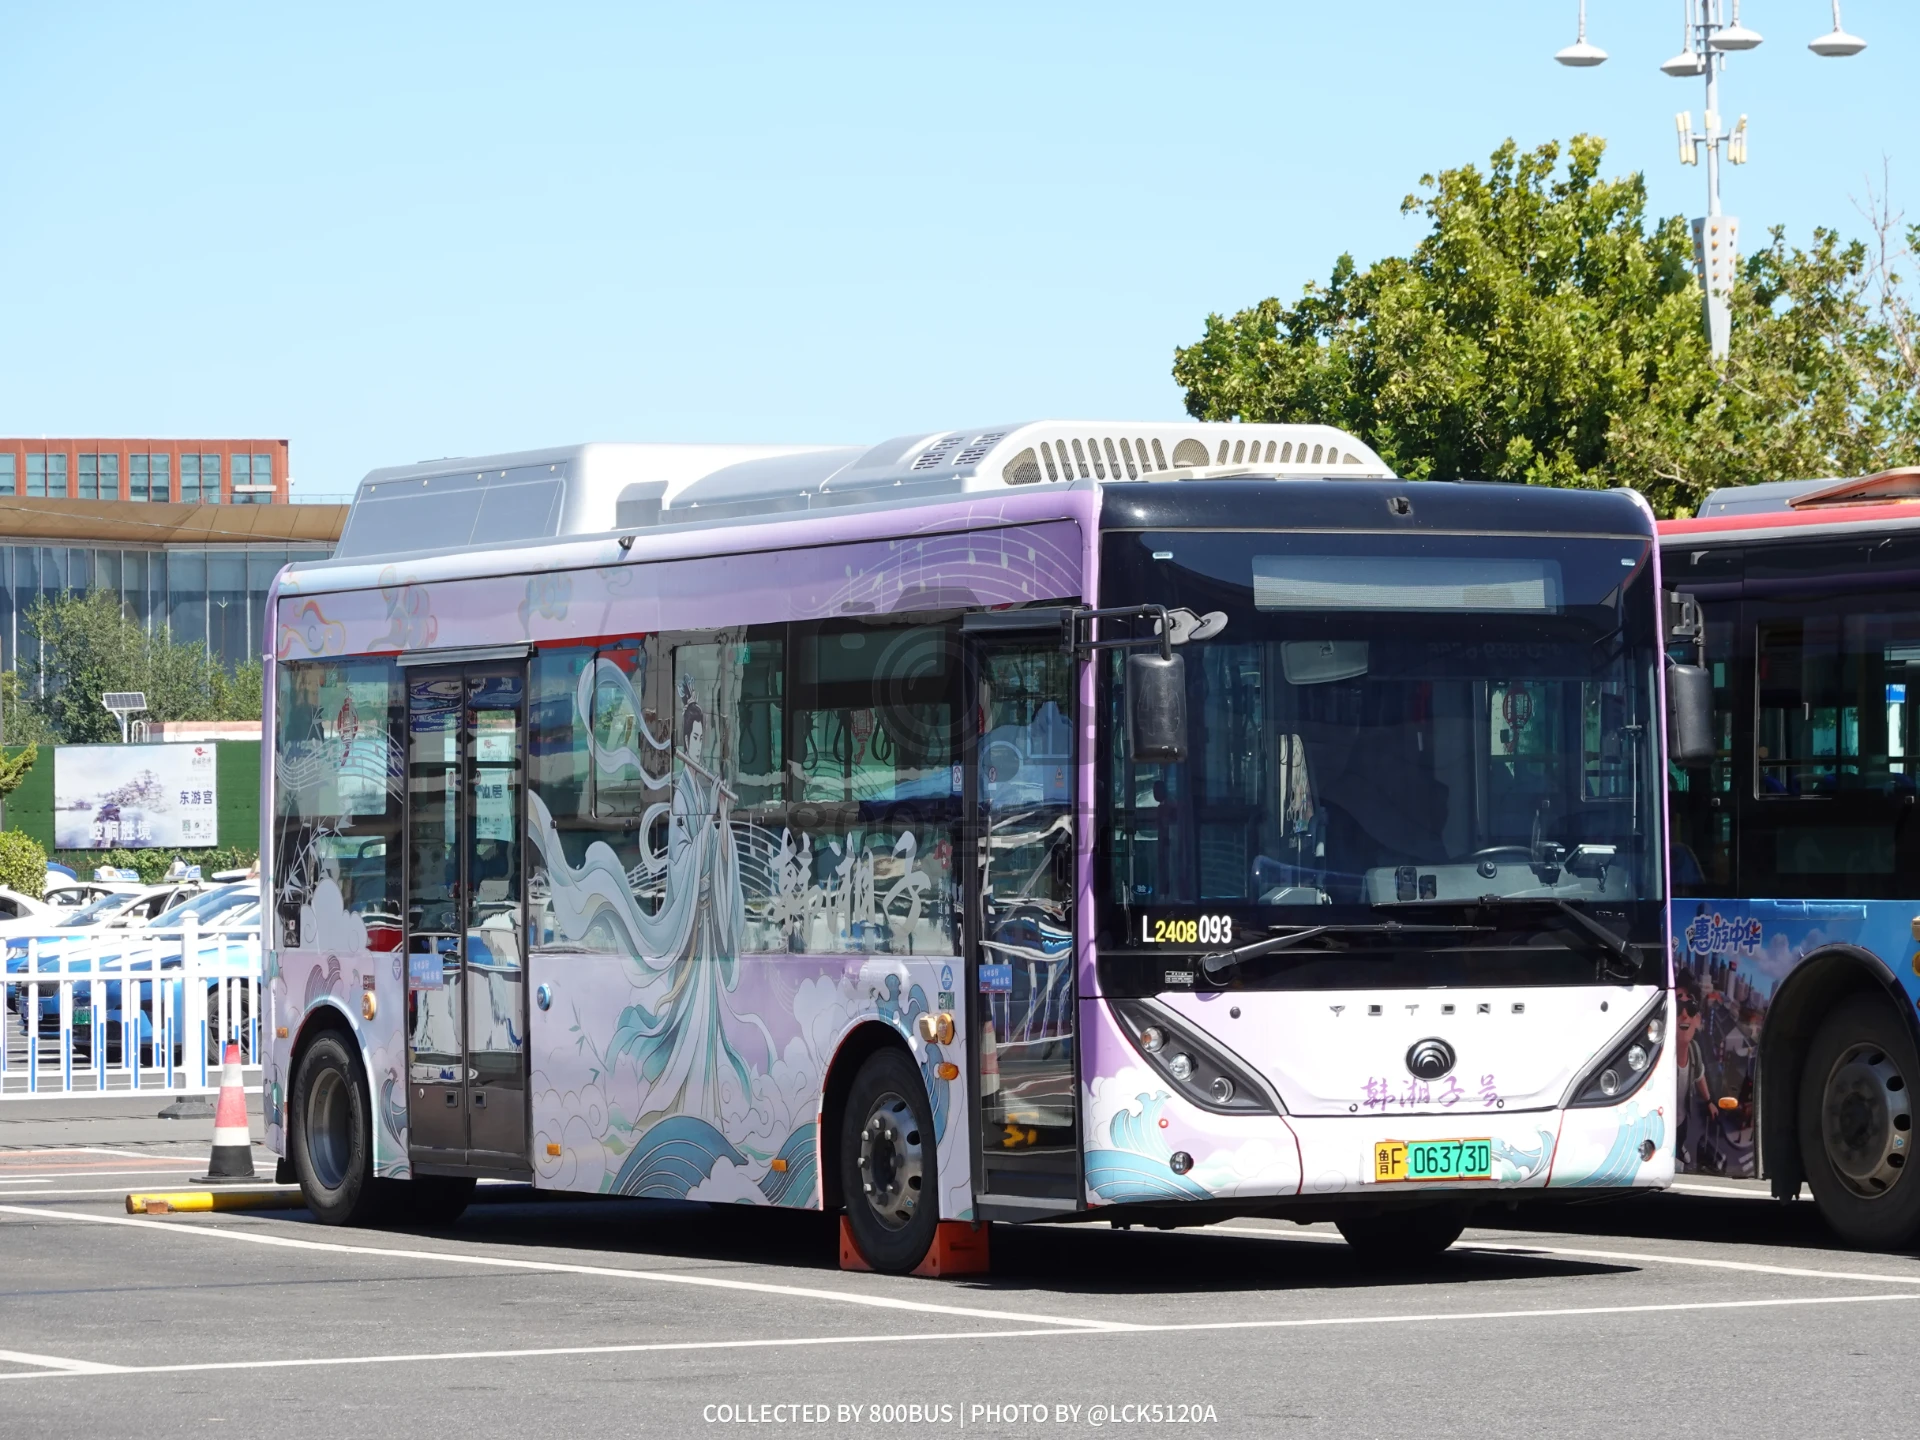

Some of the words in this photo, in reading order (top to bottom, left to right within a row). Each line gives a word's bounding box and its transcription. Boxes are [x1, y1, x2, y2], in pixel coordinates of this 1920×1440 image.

[179, 790, 213, 805] 东游宫
[90, 820, 152, 841] 崆峒胜境
[1689, 915, 1762, 954] 惠游中华
[1330, 1003, 1526, 1017] YUTONG
[1360, 1075, 1500, 1110] 韩湘子号
